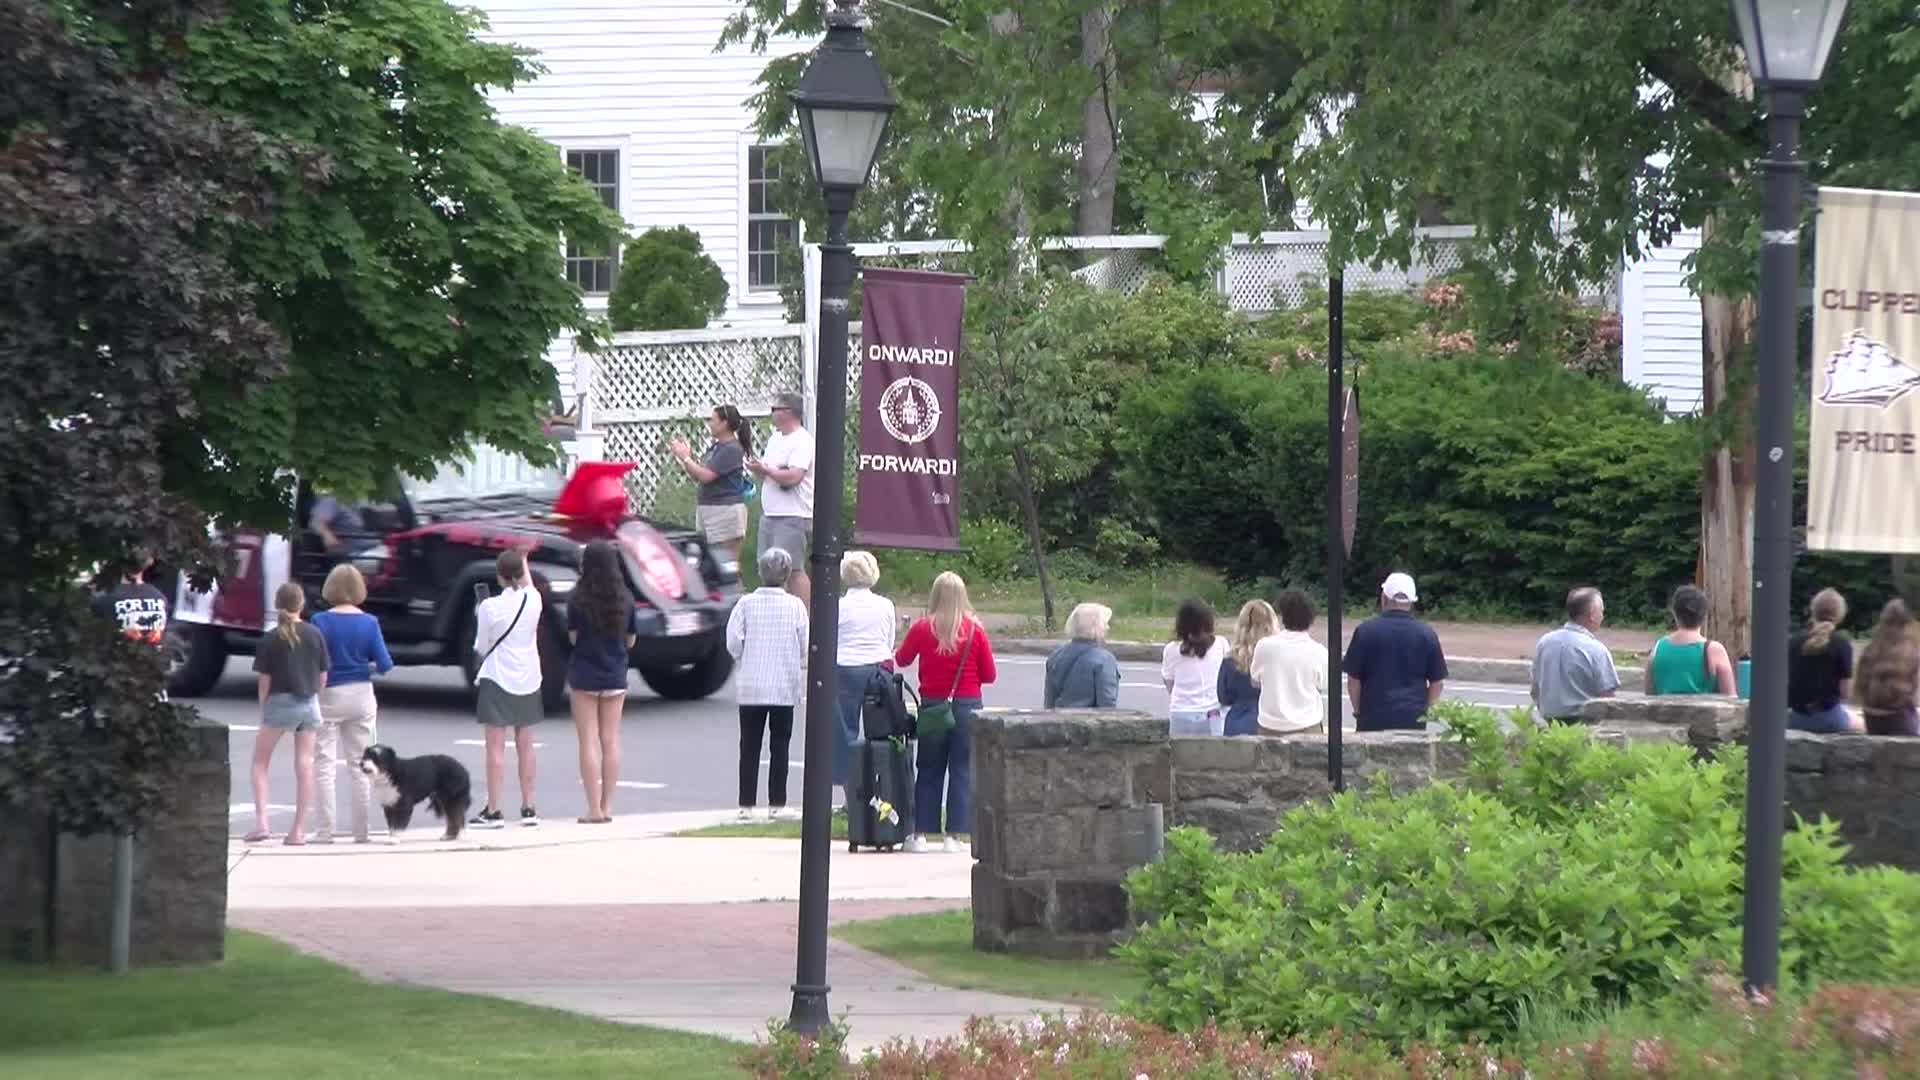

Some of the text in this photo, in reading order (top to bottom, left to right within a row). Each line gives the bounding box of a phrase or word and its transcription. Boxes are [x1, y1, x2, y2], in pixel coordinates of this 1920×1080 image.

[1821, 288, 1920, 314] CLIPPE
[1835, 431, 1915, 454] PRIDE
[115, 598, 143, 613] FOR
